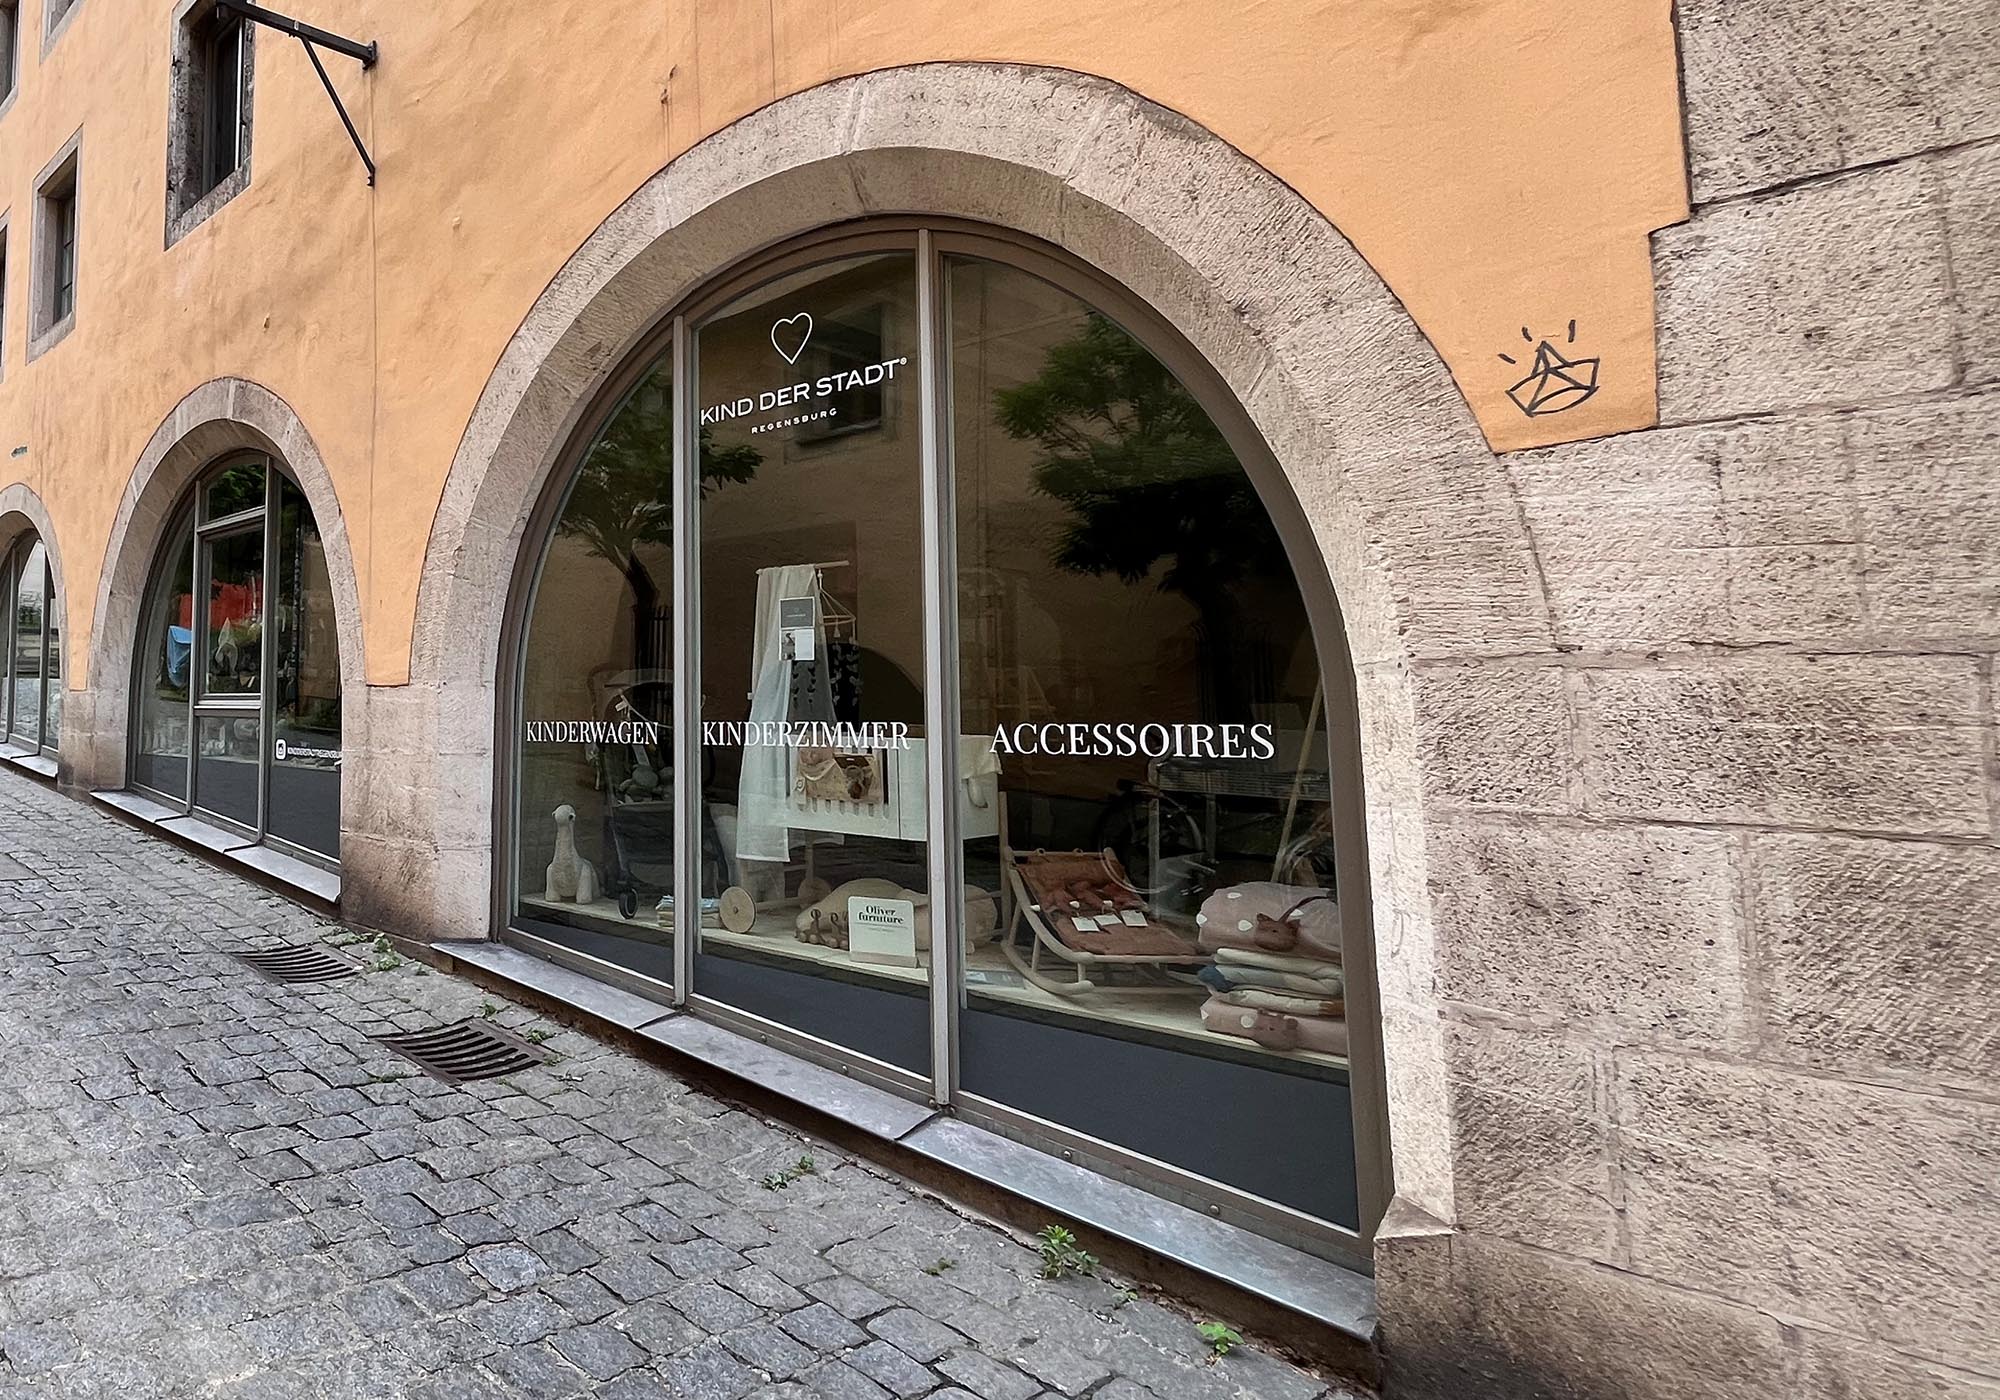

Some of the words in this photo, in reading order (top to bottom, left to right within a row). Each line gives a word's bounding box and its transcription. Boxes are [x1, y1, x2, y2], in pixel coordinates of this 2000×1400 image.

[700, 398, 754, 426] KIND
[759, 382, 810, 411] DER
[751, 407, 837, 434] REGENSBURG
[526, 720, 659, 745] KINDERWAGEN
[703, 720, 911, 750] KINDERZIMMER
[989, 723, 1275, 760] ACCESSOIRES
[858, 911, 904, 925] furniture
[865, 905, 896, 916] Oliver
